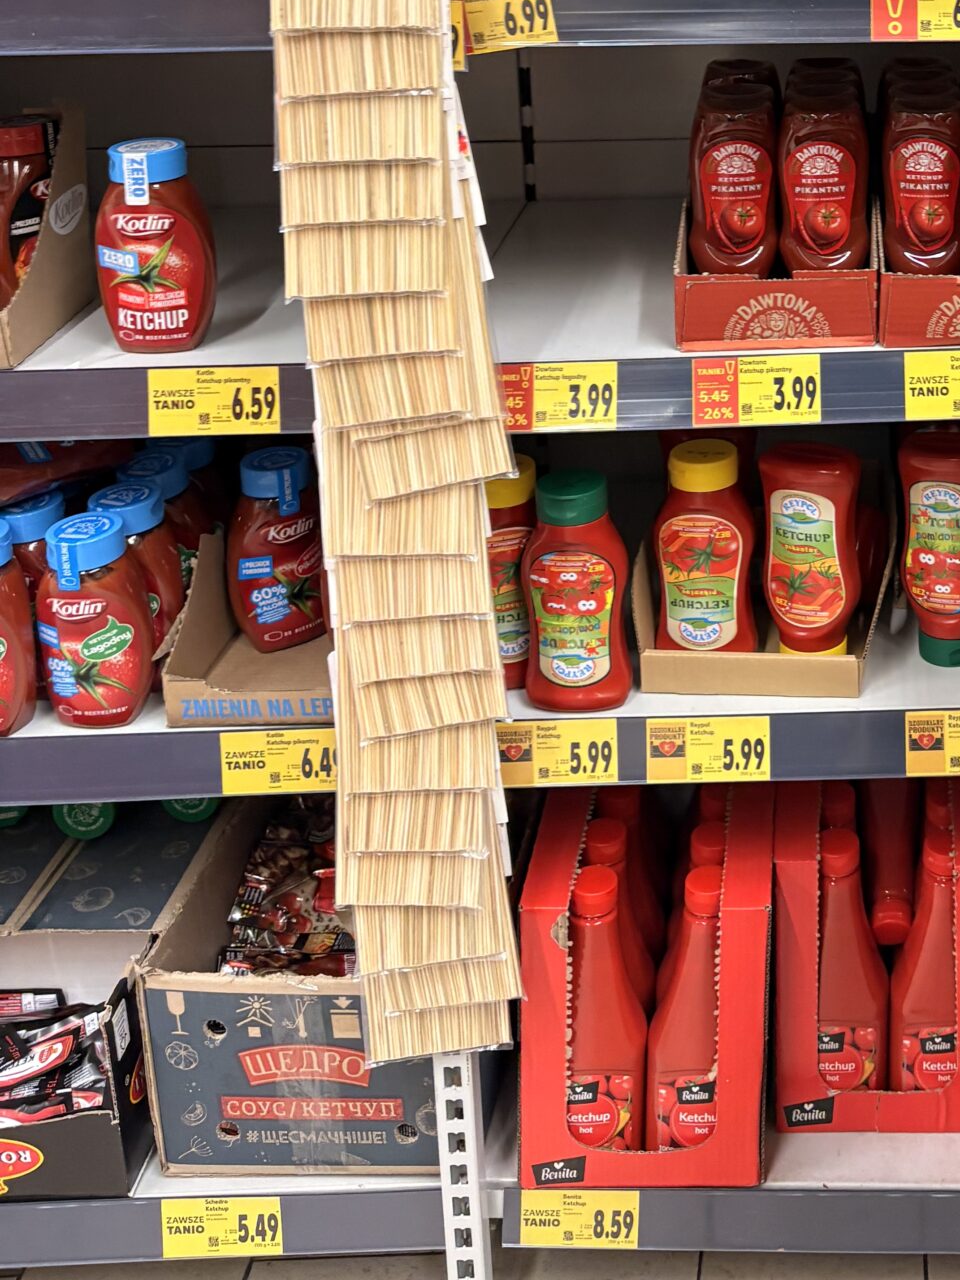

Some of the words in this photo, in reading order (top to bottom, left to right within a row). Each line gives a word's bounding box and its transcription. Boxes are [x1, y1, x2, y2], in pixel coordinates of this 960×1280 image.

[712, 143, 761, 162] DAWTONA
[795, 144, 844, 163] DAWTONA
[901, 141, 948, 160] DAWTONA
[711, 184, 763, 193] PIKANTNY
[794, 184, 846, 194] PIKANTNY
[900, 181, 950, 191] PIKANTNY
[115, 215, 173, 233] Kotlin
[102, 248, 135, 268] ZERO
[737, 292, 819, 322] DAWTONA
[118, 308, 189, 331] KETCHUP
[697, 367, 726, 376] TANIEJ
[908, 375, 949, 384] ZAWSZE
[568, 383, 613, 419] 3.99
[698, 389, 730, 402] 5.45
[773, 375, 817, 411] 3.99
[909, 386, 949, 398] TANIO
[231, 386, 276, 421] 6.59
[697, 407, 734, 420] -26%
[922, 488, 960, 508] REYPOL
[780, 497, 819, 520] REYPOL
[267, 517, 314, 542] Kotlin
[775, 528, 831, 543] KETCHUP
[251, 584, 288, 604] 60%
[51, 600, 106, 617] Kotlin
[83, 631, 132, 657] Łagodny
[180, 698, 263, 720] ZMIENIA
[268, 698, 295, 718] NA
[300, 697, 333, 718] LEP
[225, 759, 266, 770] TANIO
[569, 740, 613, 775] 5.99
[723, 737, 765, 773] 5.99
[245, 1050, 364, 1078] ЩЕДРО
[826, 1073, 840, 1082] hot
[682, 1089, 709, 1102] Benita
[791, 1108, 827, 1123] Benita
[578, 1126, 594, 1135] hot
[694, 1126, 710, 1135] hot
[523, 1209, 561, 1217] ZAWSZE
[523, 1218, 561, 1227] TANIO
[237, 1213, 279, 1244] 5.49
[592, 1210, 634, 1240] 8.59
